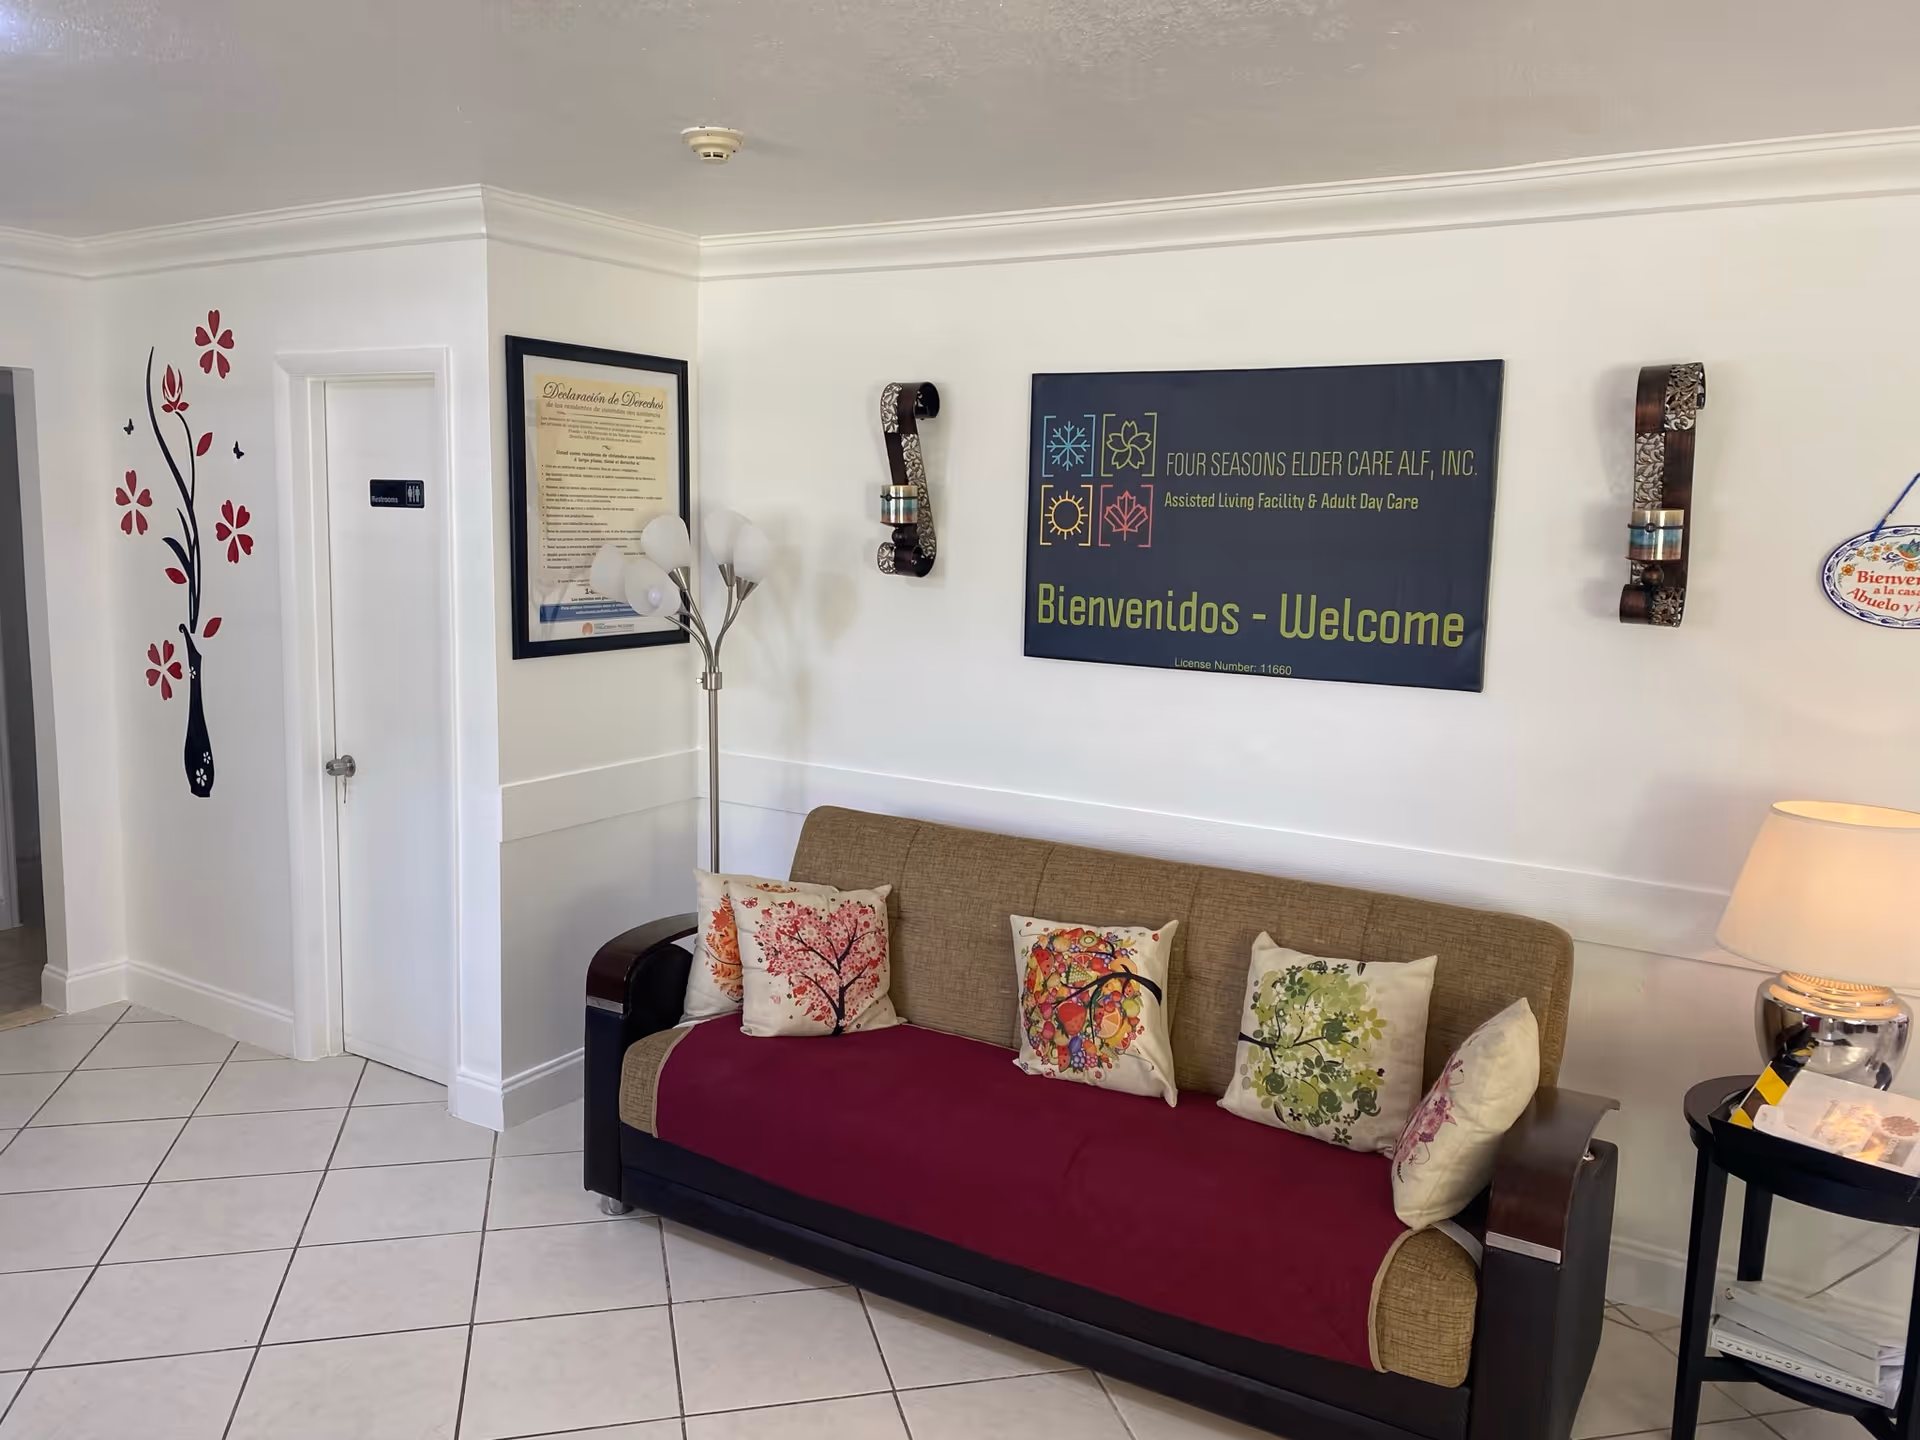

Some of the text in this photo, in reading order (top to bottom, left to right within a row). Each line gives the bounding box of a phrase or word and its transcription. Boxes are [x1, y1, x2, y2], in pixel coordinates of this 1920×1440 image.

[543, 381, 664, 410] Declaración de Derechos
[1166, 450, 1478, 481] FOUR SEASONS ELDER CARE ALF, INC.
[1164, 492, 1419, 512] Assisted Living Facility & Adult Day Care
[1846, 587, 1900, 612] Abuelo
[1903, 604, 1914, 617] y
[1883, 586, 1895, 595] la
[1038, 583, 1240, 635] Bienvenidos
[1280, 593, 1465, 648] Welcome
[1174, 657, 1292, 675] License Number: 11660
